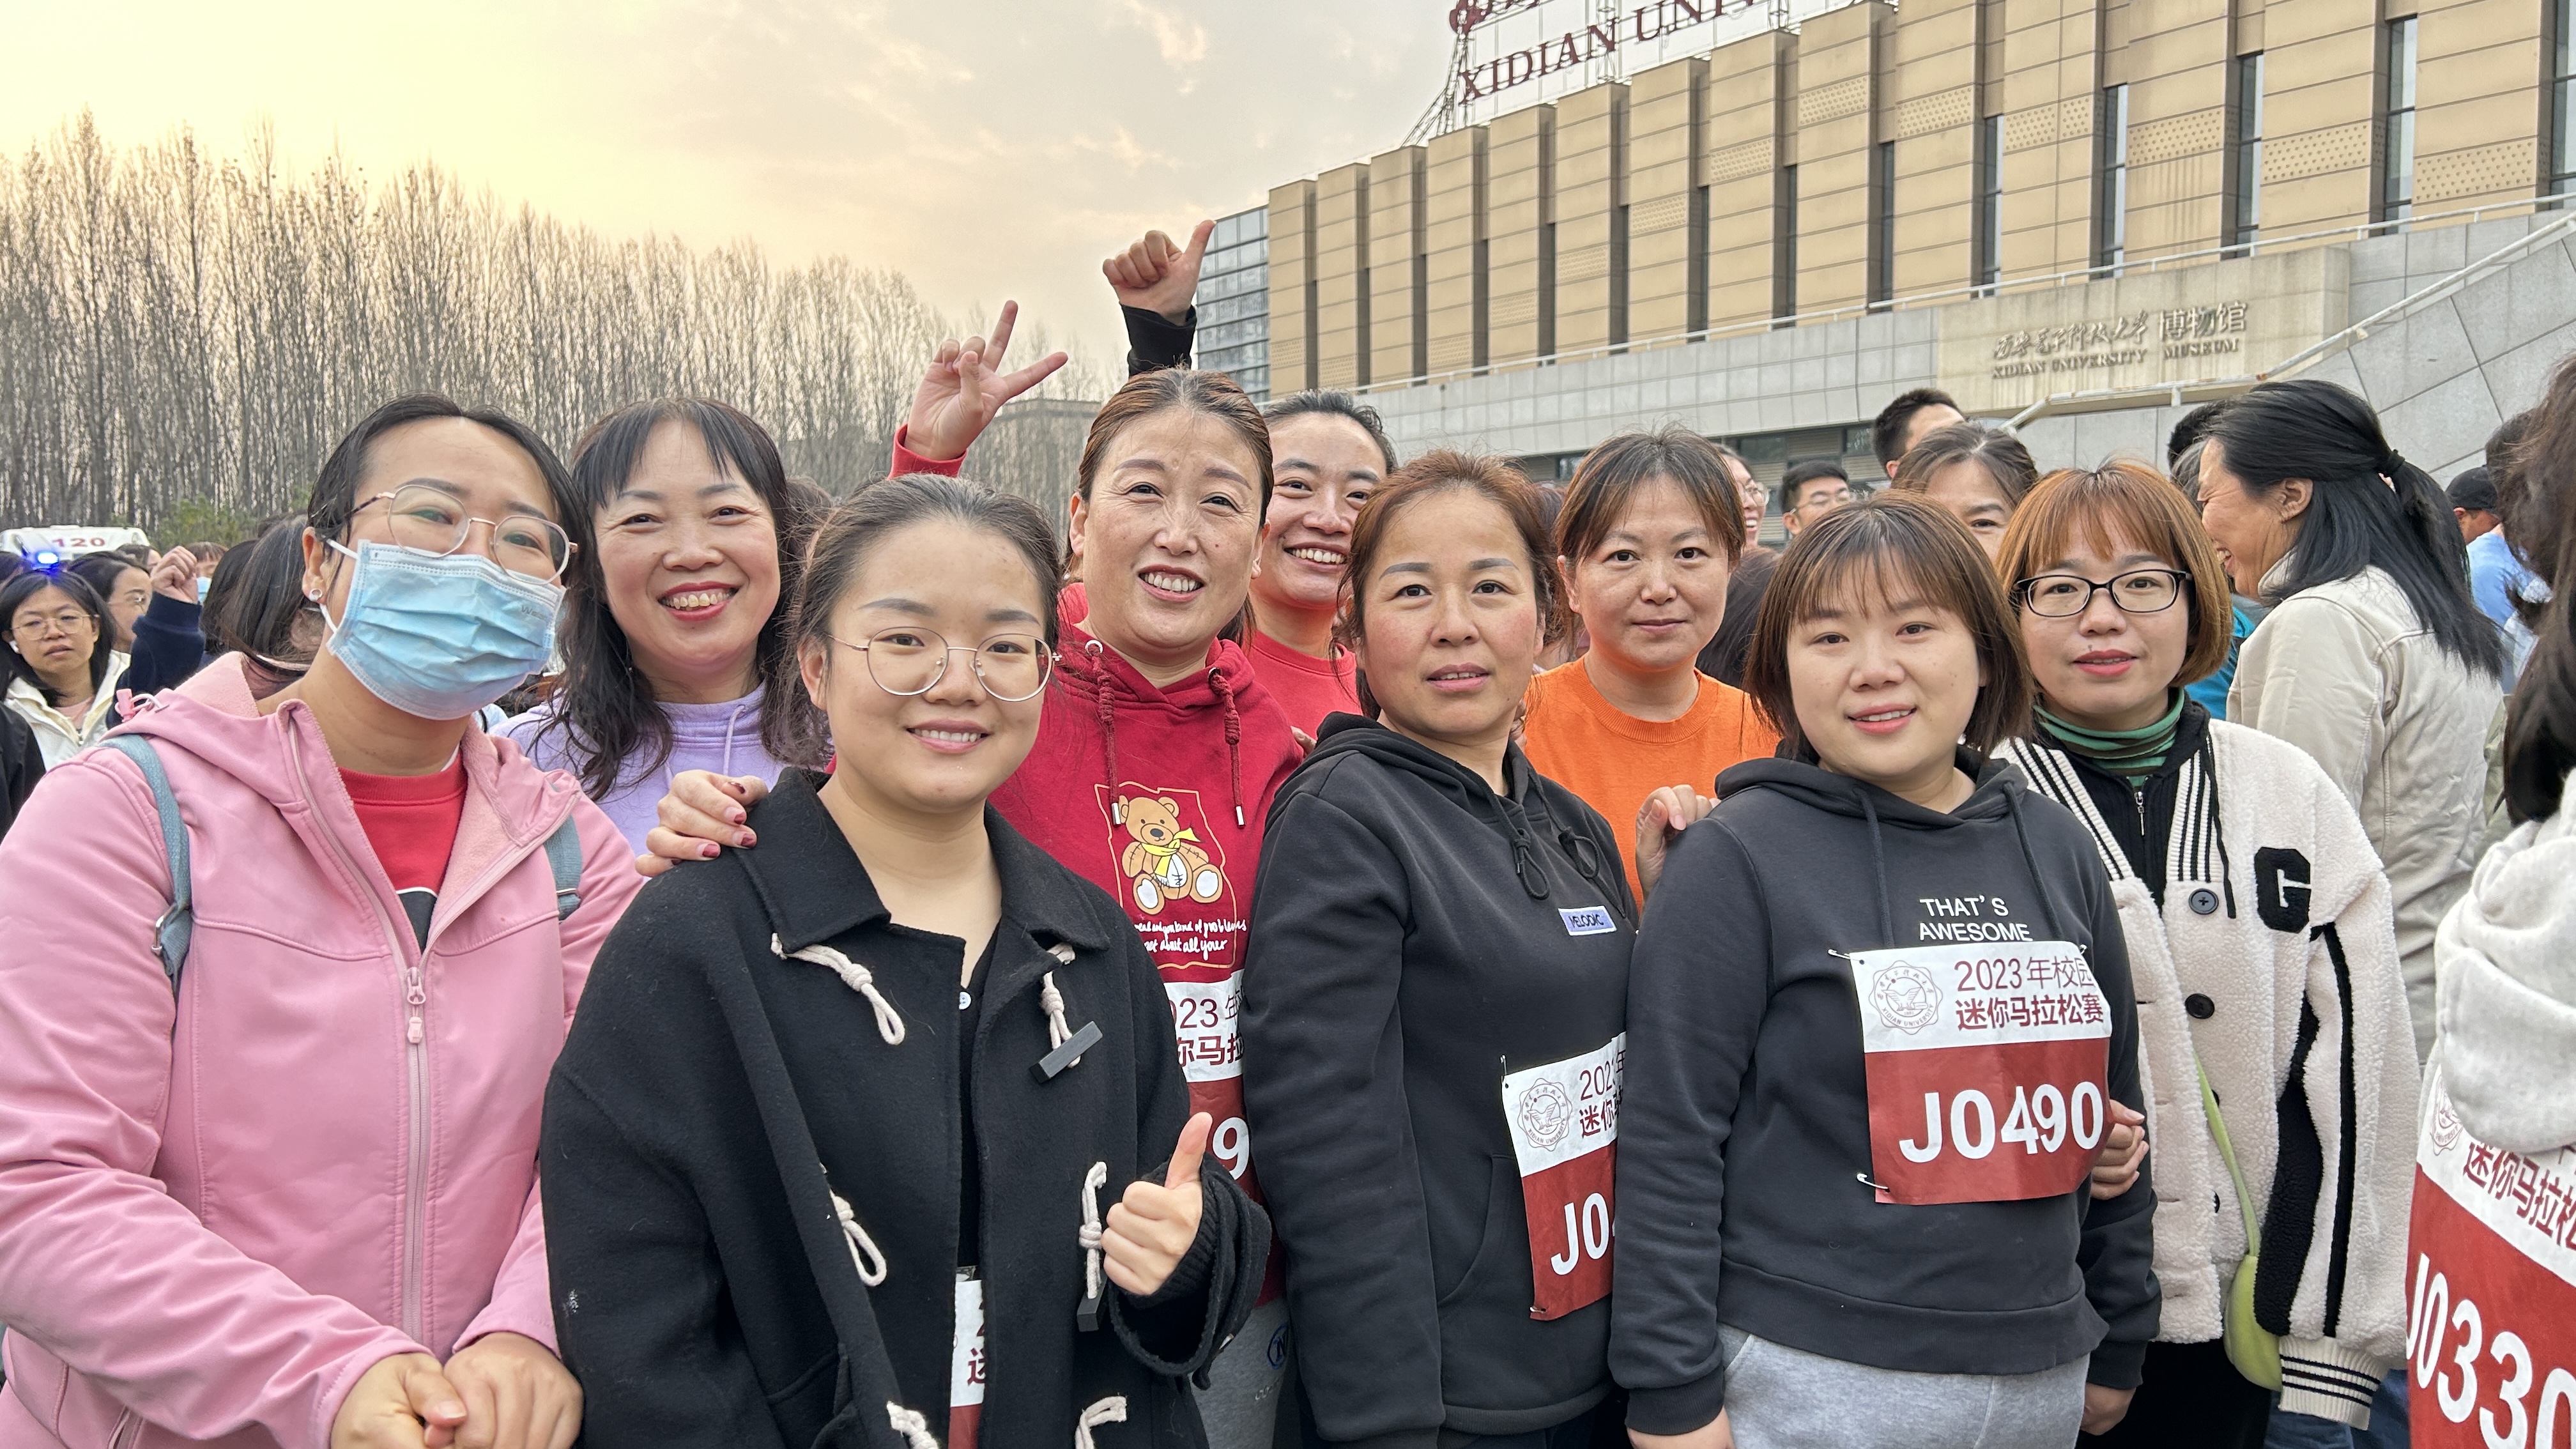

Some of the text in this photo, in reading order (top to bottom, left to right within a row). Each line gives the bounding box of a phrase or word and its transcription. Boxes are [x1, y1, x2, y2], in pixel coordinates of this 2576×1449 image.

[1458, 17, 1616, 105] XIDIAN
[2159, 301, 2248, 342] 博物馆
[1992, 339, 2239, 379] XIDIAN UNIVERSITY MUSEUM
[52, 537, 105, 548] 120
[1183, 936, 1201, 953] all
[1919, 922, 2034, 942] AWESOME
[1954, 956, 2096, 992] 2023年校园
[1882, 1004, 1935, 1027] XIDIAN UNIVERSITY
[1954, 993, 2104, 1032] 迷你马拉松赛
[1898, 1081, 2104, 1163] J0490
[1551, 1192, 1616, 1276] J0
